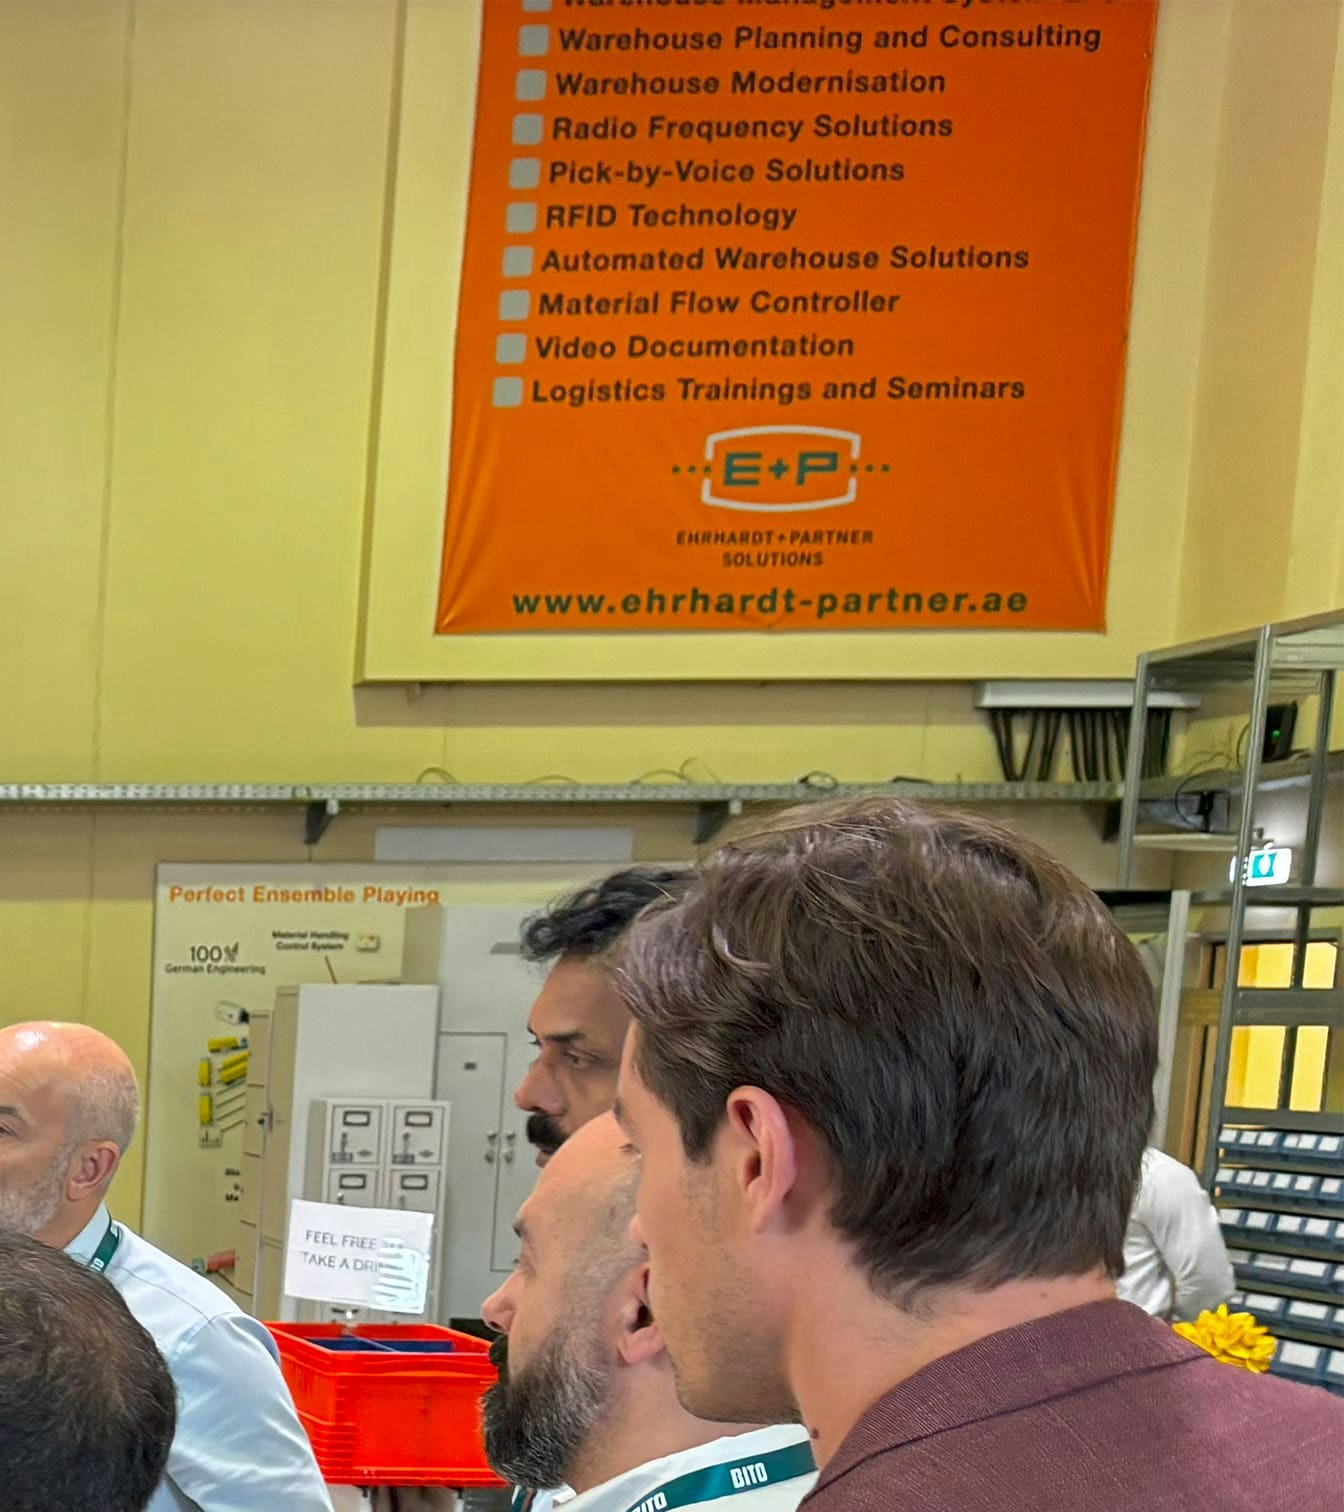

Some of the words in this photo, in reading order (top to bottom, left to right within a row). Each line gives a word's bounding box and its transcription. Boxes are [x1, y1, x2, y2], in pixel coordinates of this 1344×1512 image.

[558, 28, 723, 51] Warehouse
[734, 26, 863, 53] Planning
[873, 26, 928, 49] and
[939, 23, 1102, 52] Consulting
[555, 71, 721, 96] Warehouse
[732, 70, 947, 95] Modernisation
[552, 116, 638, 141] Radio
[648, 115, 804, 143] Frequency
[812, 113, 954, 138] Solutions
[548, 159, 755, 187] Pick-by-Voice
[764, 158, 906, 183] Solutions
[545, 205, 617, 229] RFID
[628, 204, 798, 231] Technology
[541, 249, 705, 273] Automated
[715, 248, 880, 271] Warehouse
[889, 246, 1030, 269] Solutions
[538, 292, 659, 316] Material
[670, 291, 741, 314] Flow
[750, 290, 901, 313] Controller
[535, 335, 617, 359] Video
[627, 334, 855, 358] Documentation
[531, 380, 666, 407] Logistics
[677, 377, 812, 405] Trainings
[822, 376, 877, 400] and
[887, 376, 1026, 400] Seminars
[722, 551, 825, 568] SOLUTIONS
[512, 587, 1030, 619] www.ehrhardt-partner.ae
[169, 886, 246, 904] Perfect
[253, 886, 355, 904] Ensemble
[362, 885, 440, 906] Playing
[165, 963, 205, 974] German
[206, 963, 267, 975] Engineering
[305, 1229, 338, 1247] FEEL
[341, 1234, 378, 1251] FREE
[302, 1251, 336, 1269] TAKE
[339, 1258, 350, 1269] A
[729, 1462, 768, 1489] BITO
